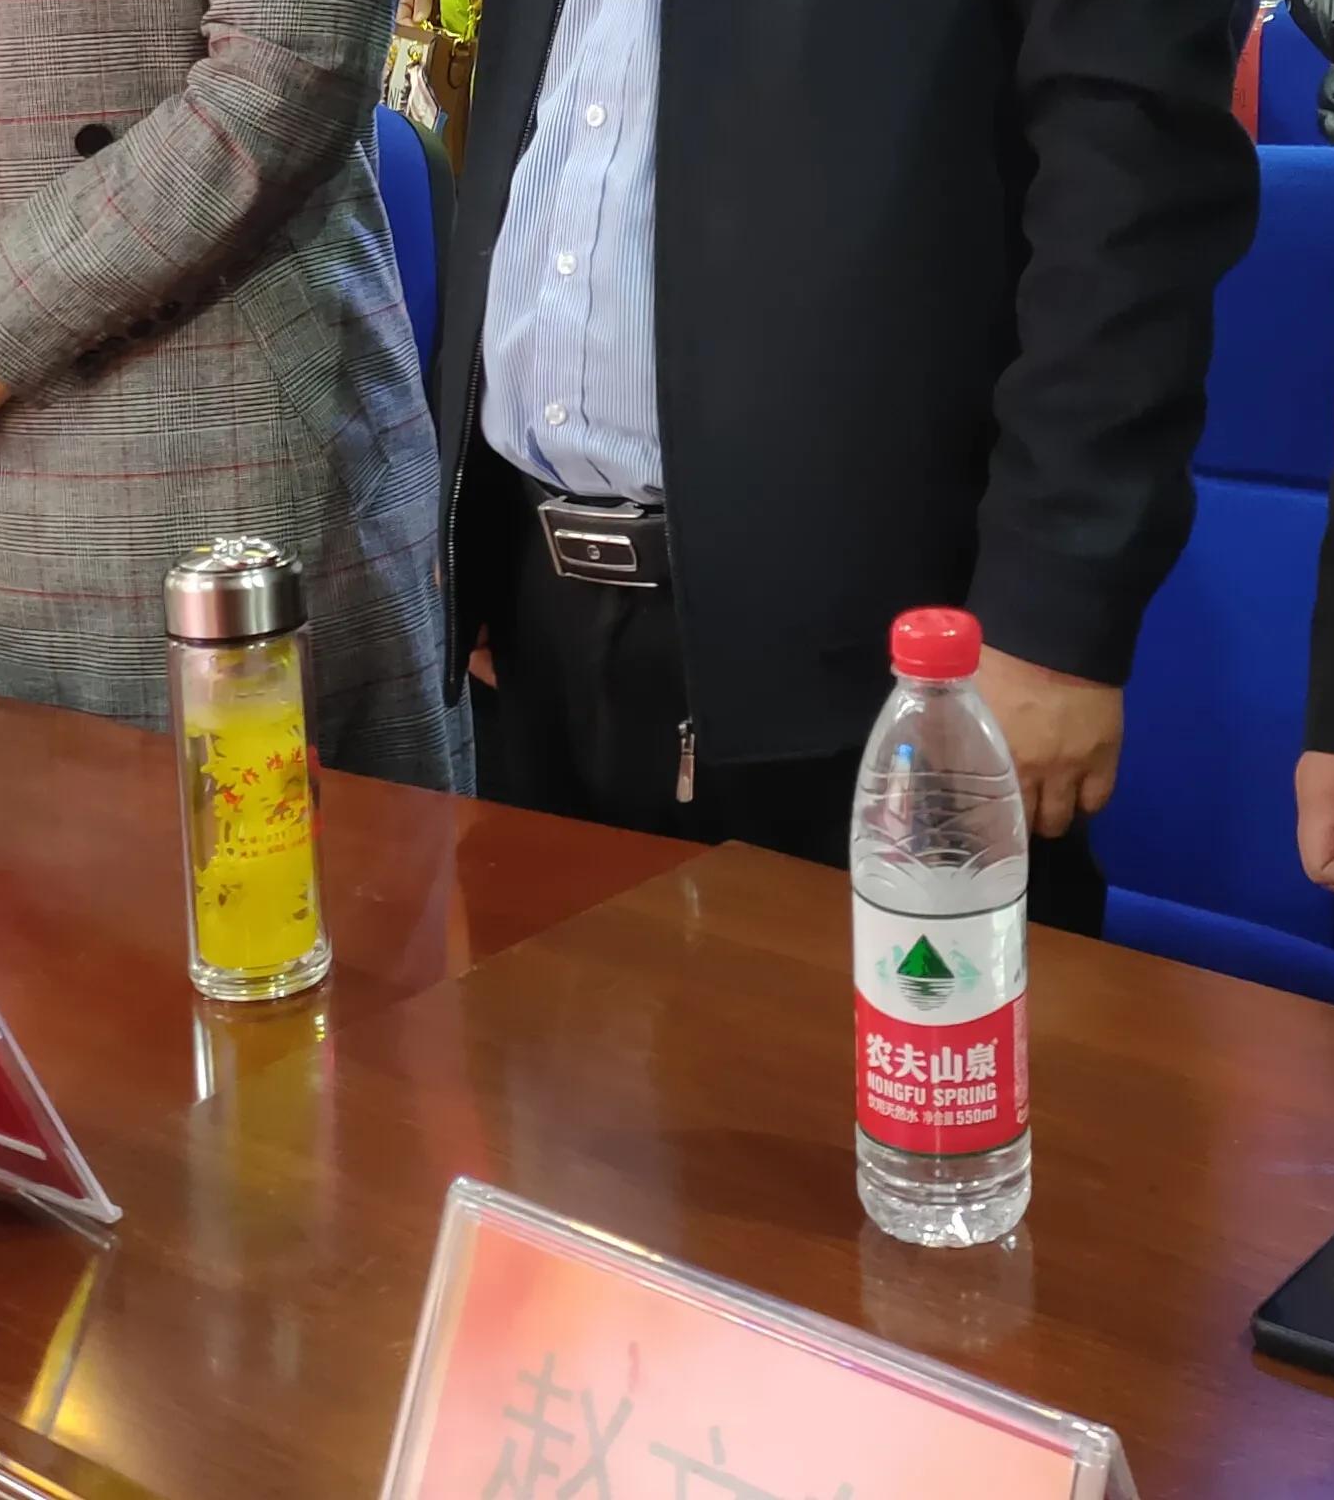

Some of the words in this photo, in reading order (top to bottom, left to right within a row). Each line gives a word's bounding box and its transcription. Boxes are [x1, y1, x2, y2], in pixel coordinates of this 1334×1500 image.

[866, 1032, 997, 1085] 农夫山泉
[866, 1069, 927, 1105] NONGFU
[932, 1082, 997, 1107] SPRING
